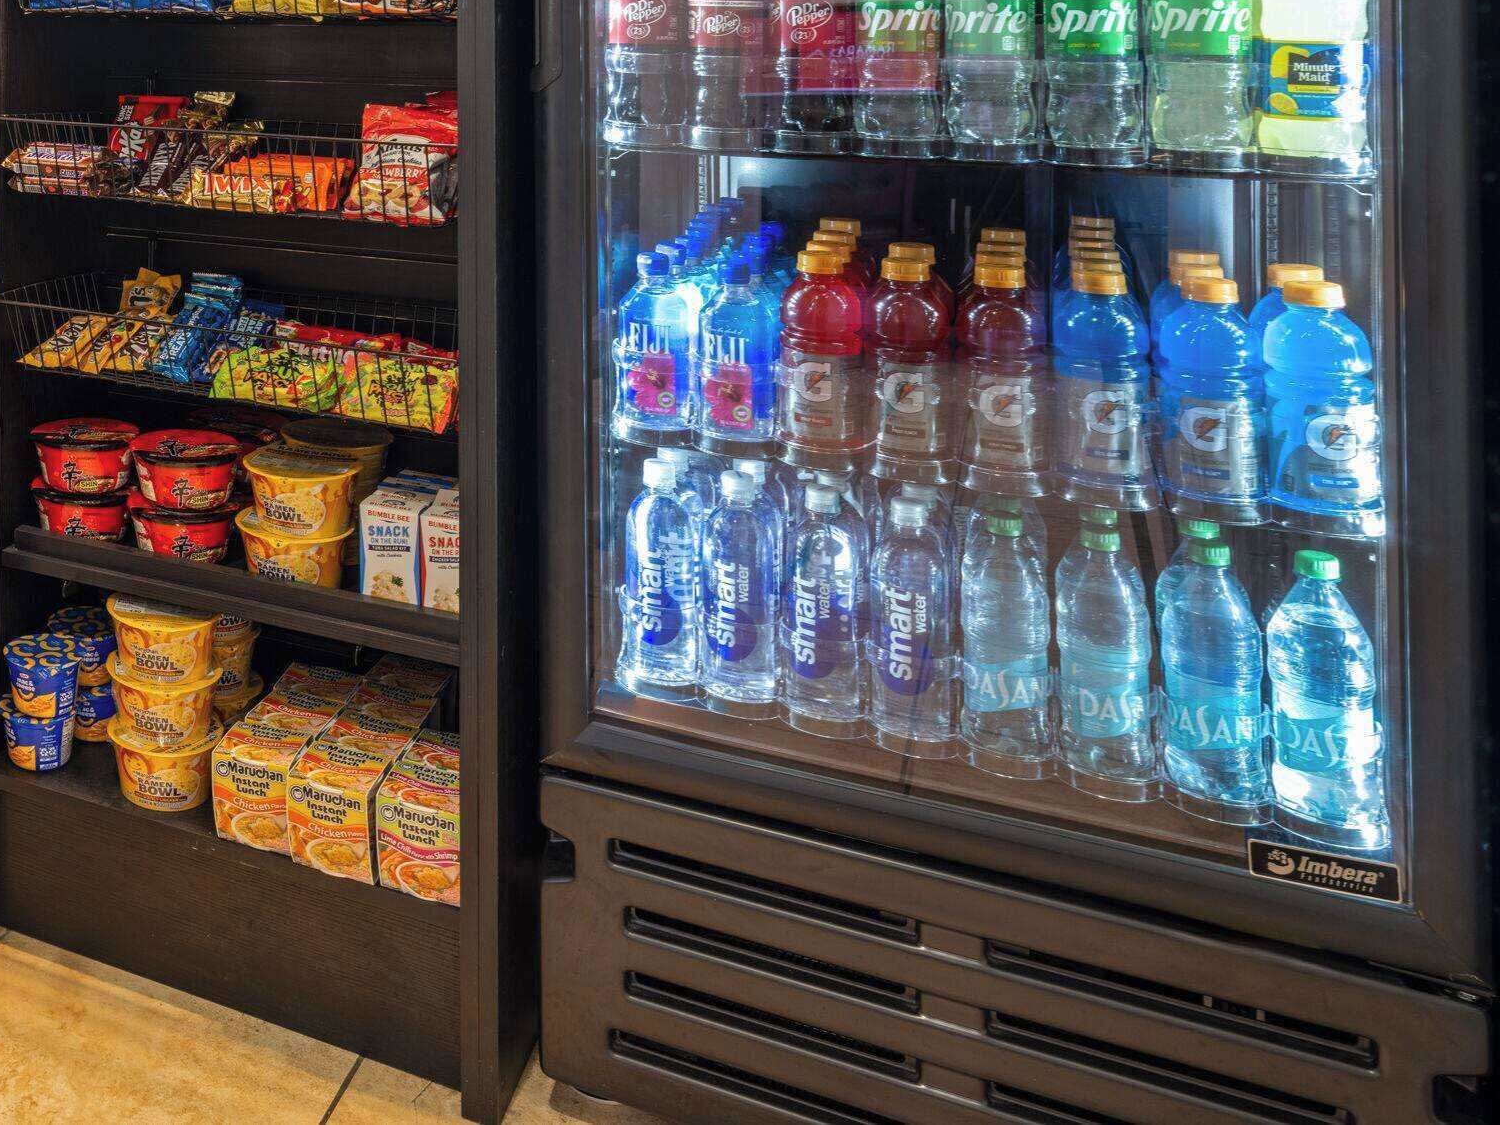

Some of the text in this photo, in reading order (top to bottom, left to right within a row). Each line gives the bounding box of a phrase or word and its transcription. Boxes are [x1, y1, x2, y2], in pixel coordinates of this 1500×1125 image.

[624, 4, 664, 22] Pepper
[801, 2, 820, 14] Dr
[704, 18, 739, 34] Pepper
[715, 14, 730, 26] Dr
[788, 7, 830, 28] Pepper
[945, 2, 1028, 40] Sprite
[1049, 0, 1138, 41] Sprite
[1293, 62, 1337, 73] Minute
[1298, 72, 1331, 83] Maid
[203, 175, 272, 196] TWIX
[629, 322, 671, 355] FIJI
[705, 333, 746, 366] FIJI
[793, 362, 832, 402] G
[883, 372, 926, 413] G
[979, 385, 1023, 427] G
[1082, 390, 1128, 434] G
[1179, 406, 1229, 452] G
[1304, 413, 1358, 461] G
[61, 460, 83, 492] 辛
[79, 480, 98, 489] SHIN
[192, 494, 210, 504] SHIN
[264, 502, 297, 513] RAMEN
[265, 507, 307, 524] BOWL
[367, 509, 411, 523] BUMBLE BEE
[367, 525, 410, 538] SNACK
[257, 560, 291, 573] RAMEN
[641, 550, 663, 633] smart
[737, 563, 750, 603] water
[714, 558, 736, 648] smart
[818, 585, 831, 620] water
[793, 573, 816, 665] smart
[914, 593, 927, 634] water
[885, 587, 913, 681] smart
[135, 651, 170, 662] RAMEN
[136, 658, 178, 672] BOWL
[134, 712, 169, 724] RAMEN
[134, 719, 178, 733] BOWL
[326, 744, 384, 763] Maruchan
[227, 761, 284, 783] Maruchan
[319, 760, 359, 775] Chicken
[137, 777, 173, 790] RAMEN
[138, 785, 182, 798] BOWL
[231, 775, 271, 790] Instant
[236, 784, 267, 798] Lunch
[233, 796, 271, 812] Chicken
[303, 784, 362, 811] Maruchan
[306, 800, 348, 818] Instant
[311, 810, 344, 825] Lunch
[392, 804, 456, 833] Maruchan
[307, 822, 347, 839] Chicken
[398, 821, 441, 839] Instant
[402, 831, 437, 847] Lunch
[381, 832, 459, 863] Lime Shrimp
[1297, 856, 1379, 886] Imbera
